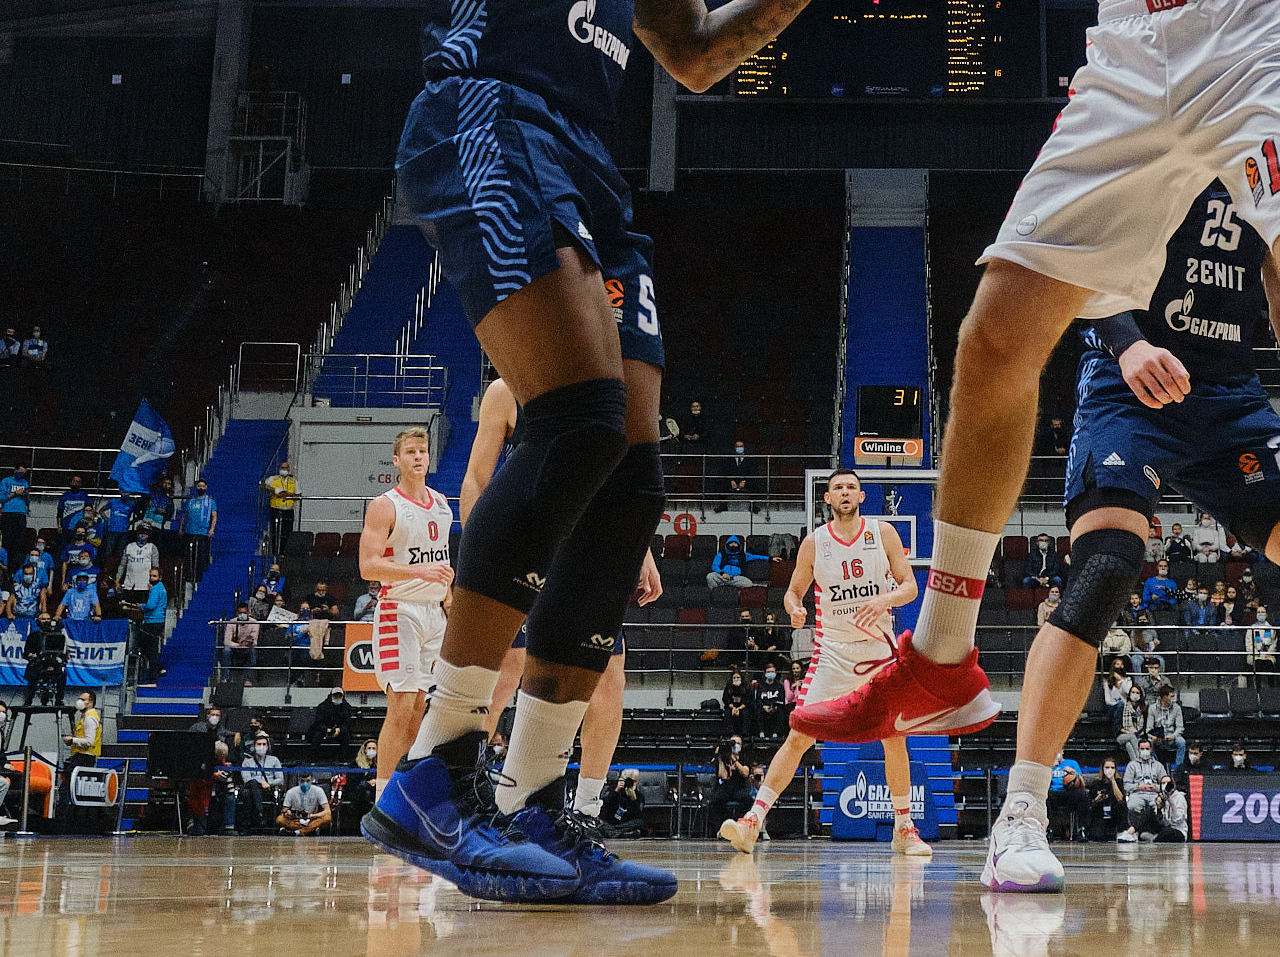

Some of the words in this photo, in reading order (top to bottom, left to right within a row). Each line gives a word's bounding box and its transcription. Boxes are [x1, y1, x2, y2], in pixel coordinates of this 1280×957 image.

[1200, 199, 1242, 251] 25
[1185, 257, 1246, 292] ZENIT
[637, 273, 663, 336] 5
[1190, 317, 1242, 343] GAZPROM
[864, 442, 902, 453] Winline
[428, 521, 438, 541] 0
[842, 559, 863, 580] 16
[929, 571, 970, 597] GSA
[65, 646, 118, 660] ЕНИТ
[868, 785, 925, 801] GAZM
